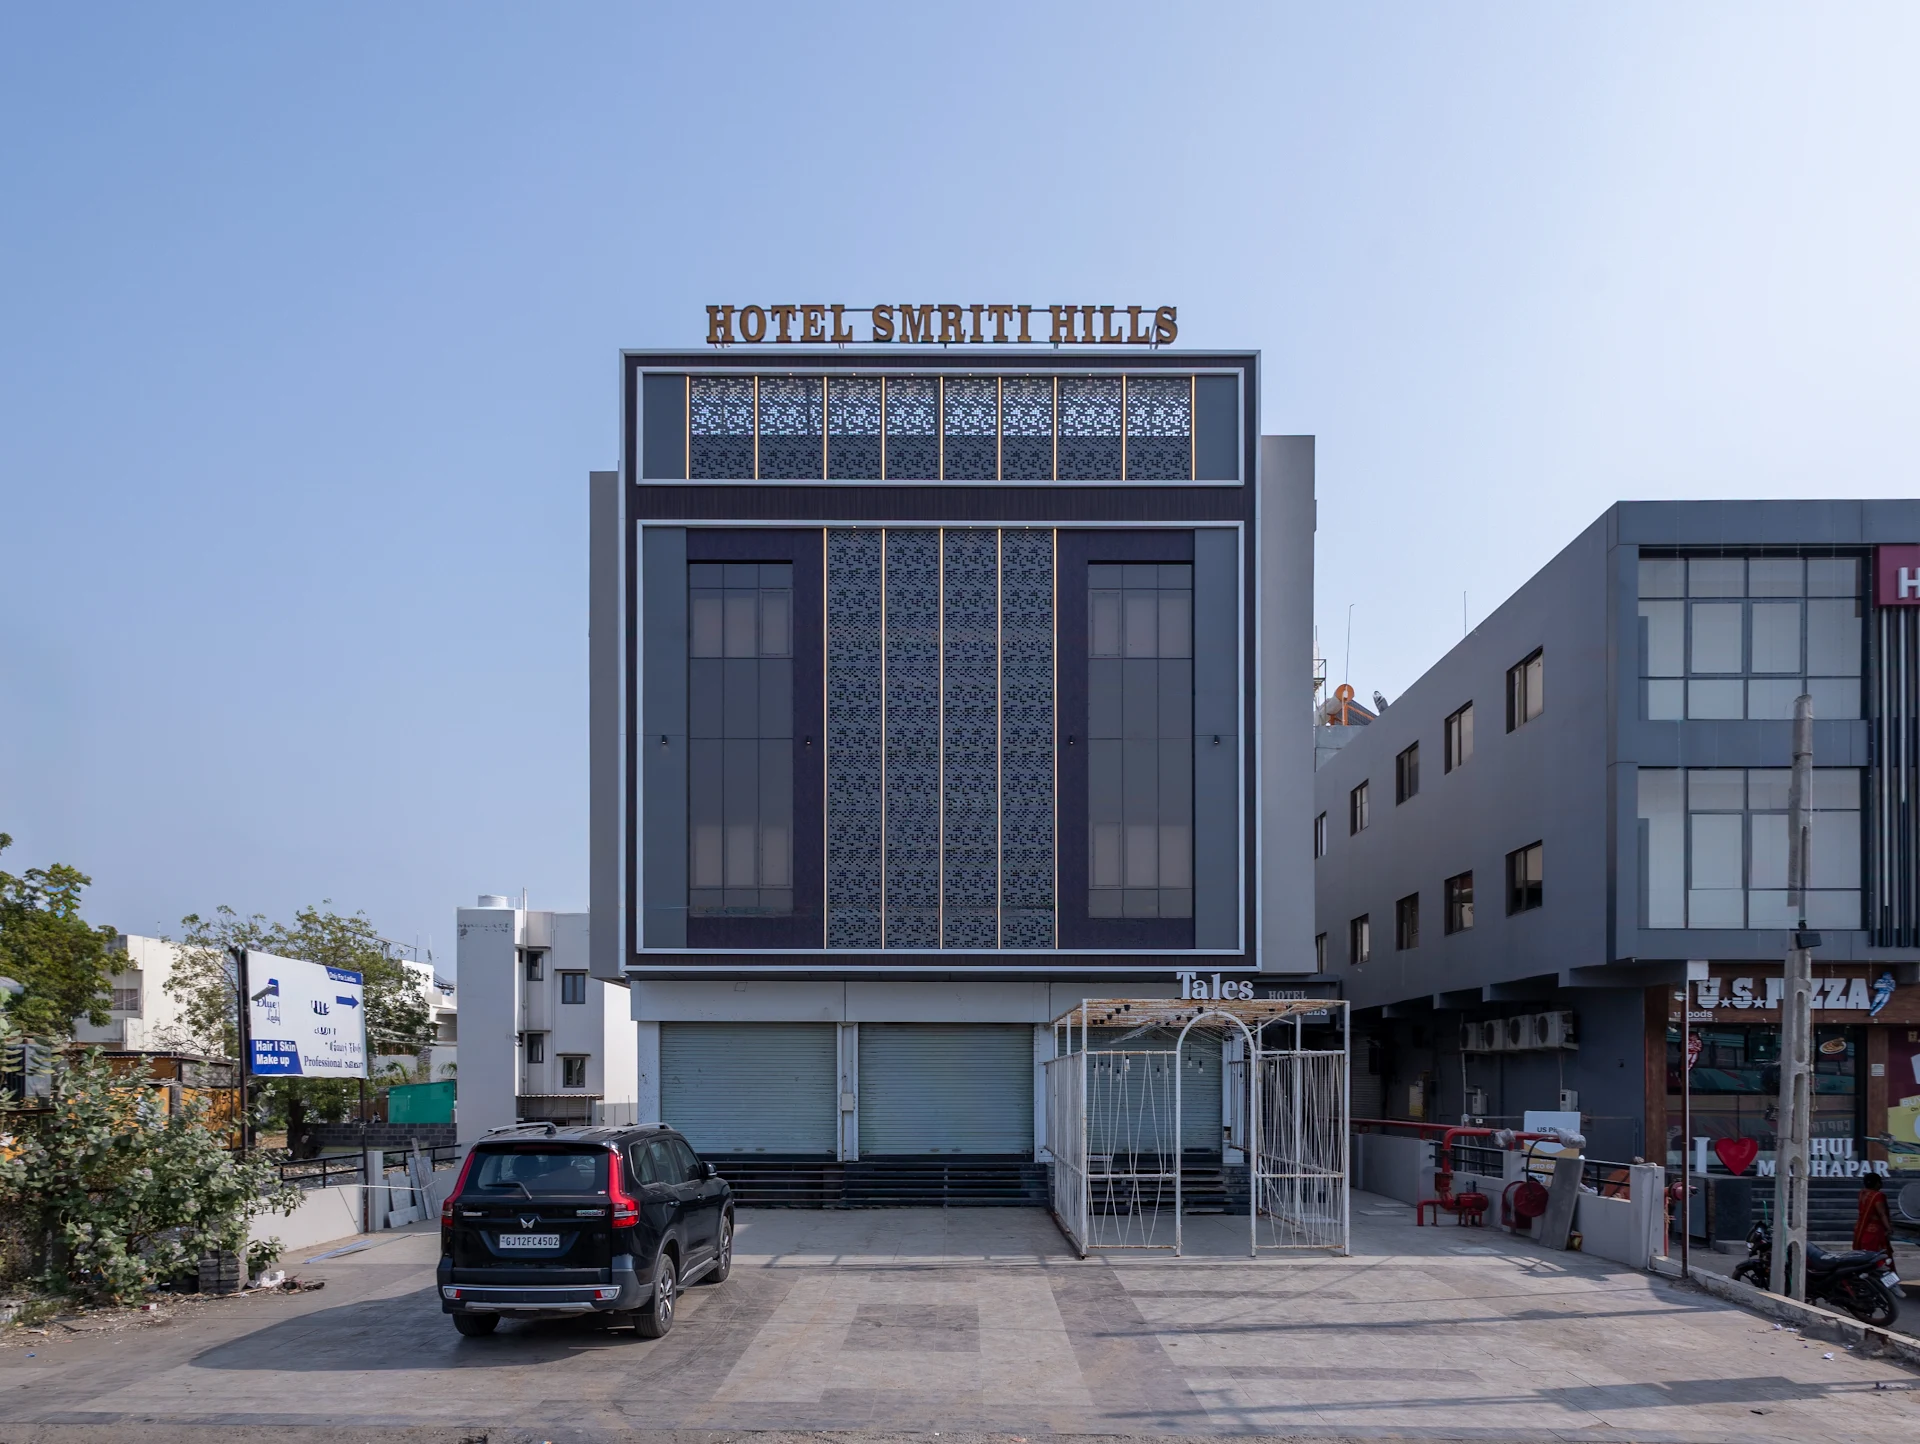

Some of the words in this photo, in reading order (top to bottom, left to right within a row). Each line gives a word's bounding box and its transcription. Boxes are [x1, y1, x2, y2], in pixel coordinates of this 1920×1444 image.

[706, 304, 853, 343] HOTEL
[872, 304, 1032, 343] SMRITI
[1049, 305, 1178, 345] HILLS
[1176, 971, 1255, 1001] Tales
[1268, 990, 1308, 1000] HOTEL
[1766, 978, 1871, 1010] PZZA
[256, 1040, 273, 1052] Hair
[279, 1041, 297, 1053] Skin
[256, 1054, 279, 1065] Make
[280, 1056, 290, 1067] up
[304, 1055, 343, 1069] Professional
[1693, 1136, 1711, 1174] I
[1809, 1137, 1854, 1159] HUJ
[505, 1236, 559, 1246] GJ12FC4502
